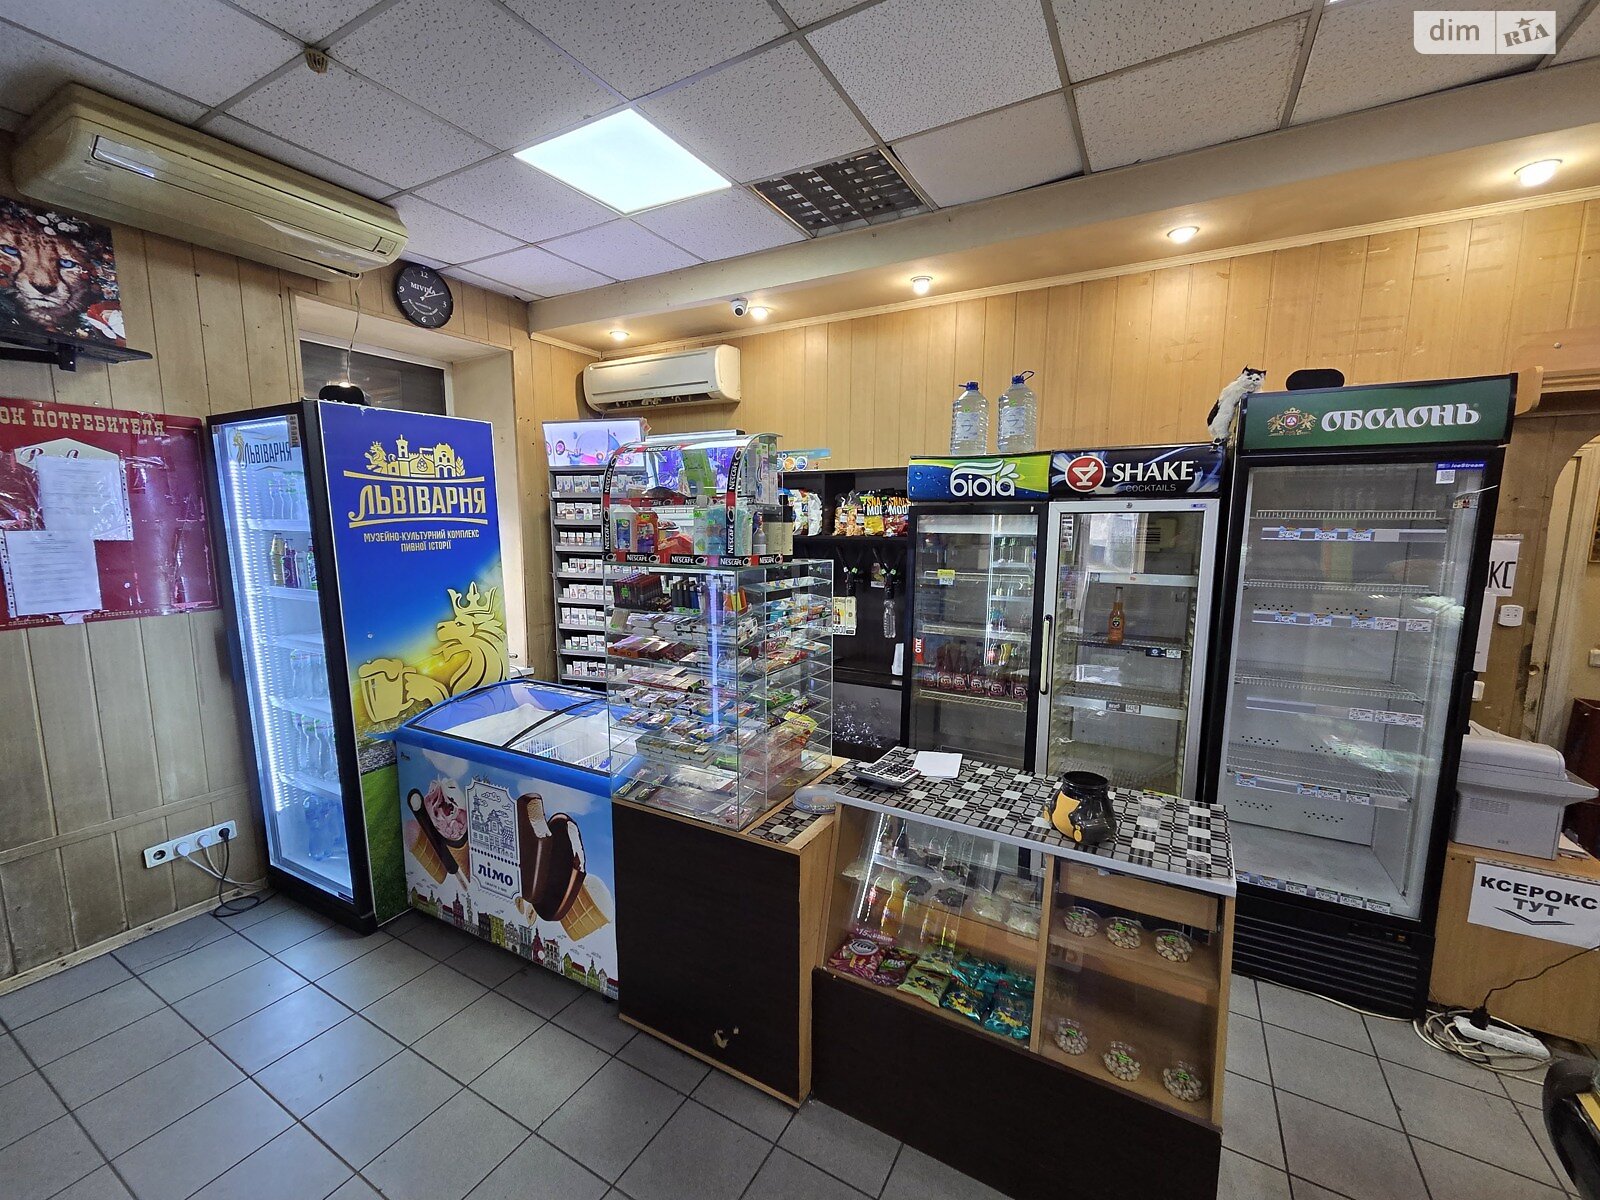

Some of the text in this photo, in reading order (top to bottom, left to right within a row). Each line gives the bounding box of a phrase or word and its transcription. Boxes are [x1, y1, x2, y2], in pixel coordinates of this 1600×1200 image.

[32, 409, 170, 437] ПОТРЕБИТЕЛЯ
[1321, 403, 1481, 432] ОБОЛОНЬ
[242, 441, 293, 469] ЛЬВІВАРНЯ
[950, 465, 1016, 497] biola
[1112, 460, 1194, 482] SHAKE
[1125, 483, 1177, 493] COCKTAILS
[347, 485, 487, 521] ЛЬВІВАРНЯ
[363, 529, 480, 543] МУЗЕЙНО-КУЛЬТУРНИЙ КОМПЛЕКС
[400, 540, 452, 552] ПИВНОЇ ІСТОРІЇ
[477, 861, 514, 887] лімо
[1480, 875, 1598, 910] КСЕРОКС
[1512, 897, 1560, 917] ТУТ
